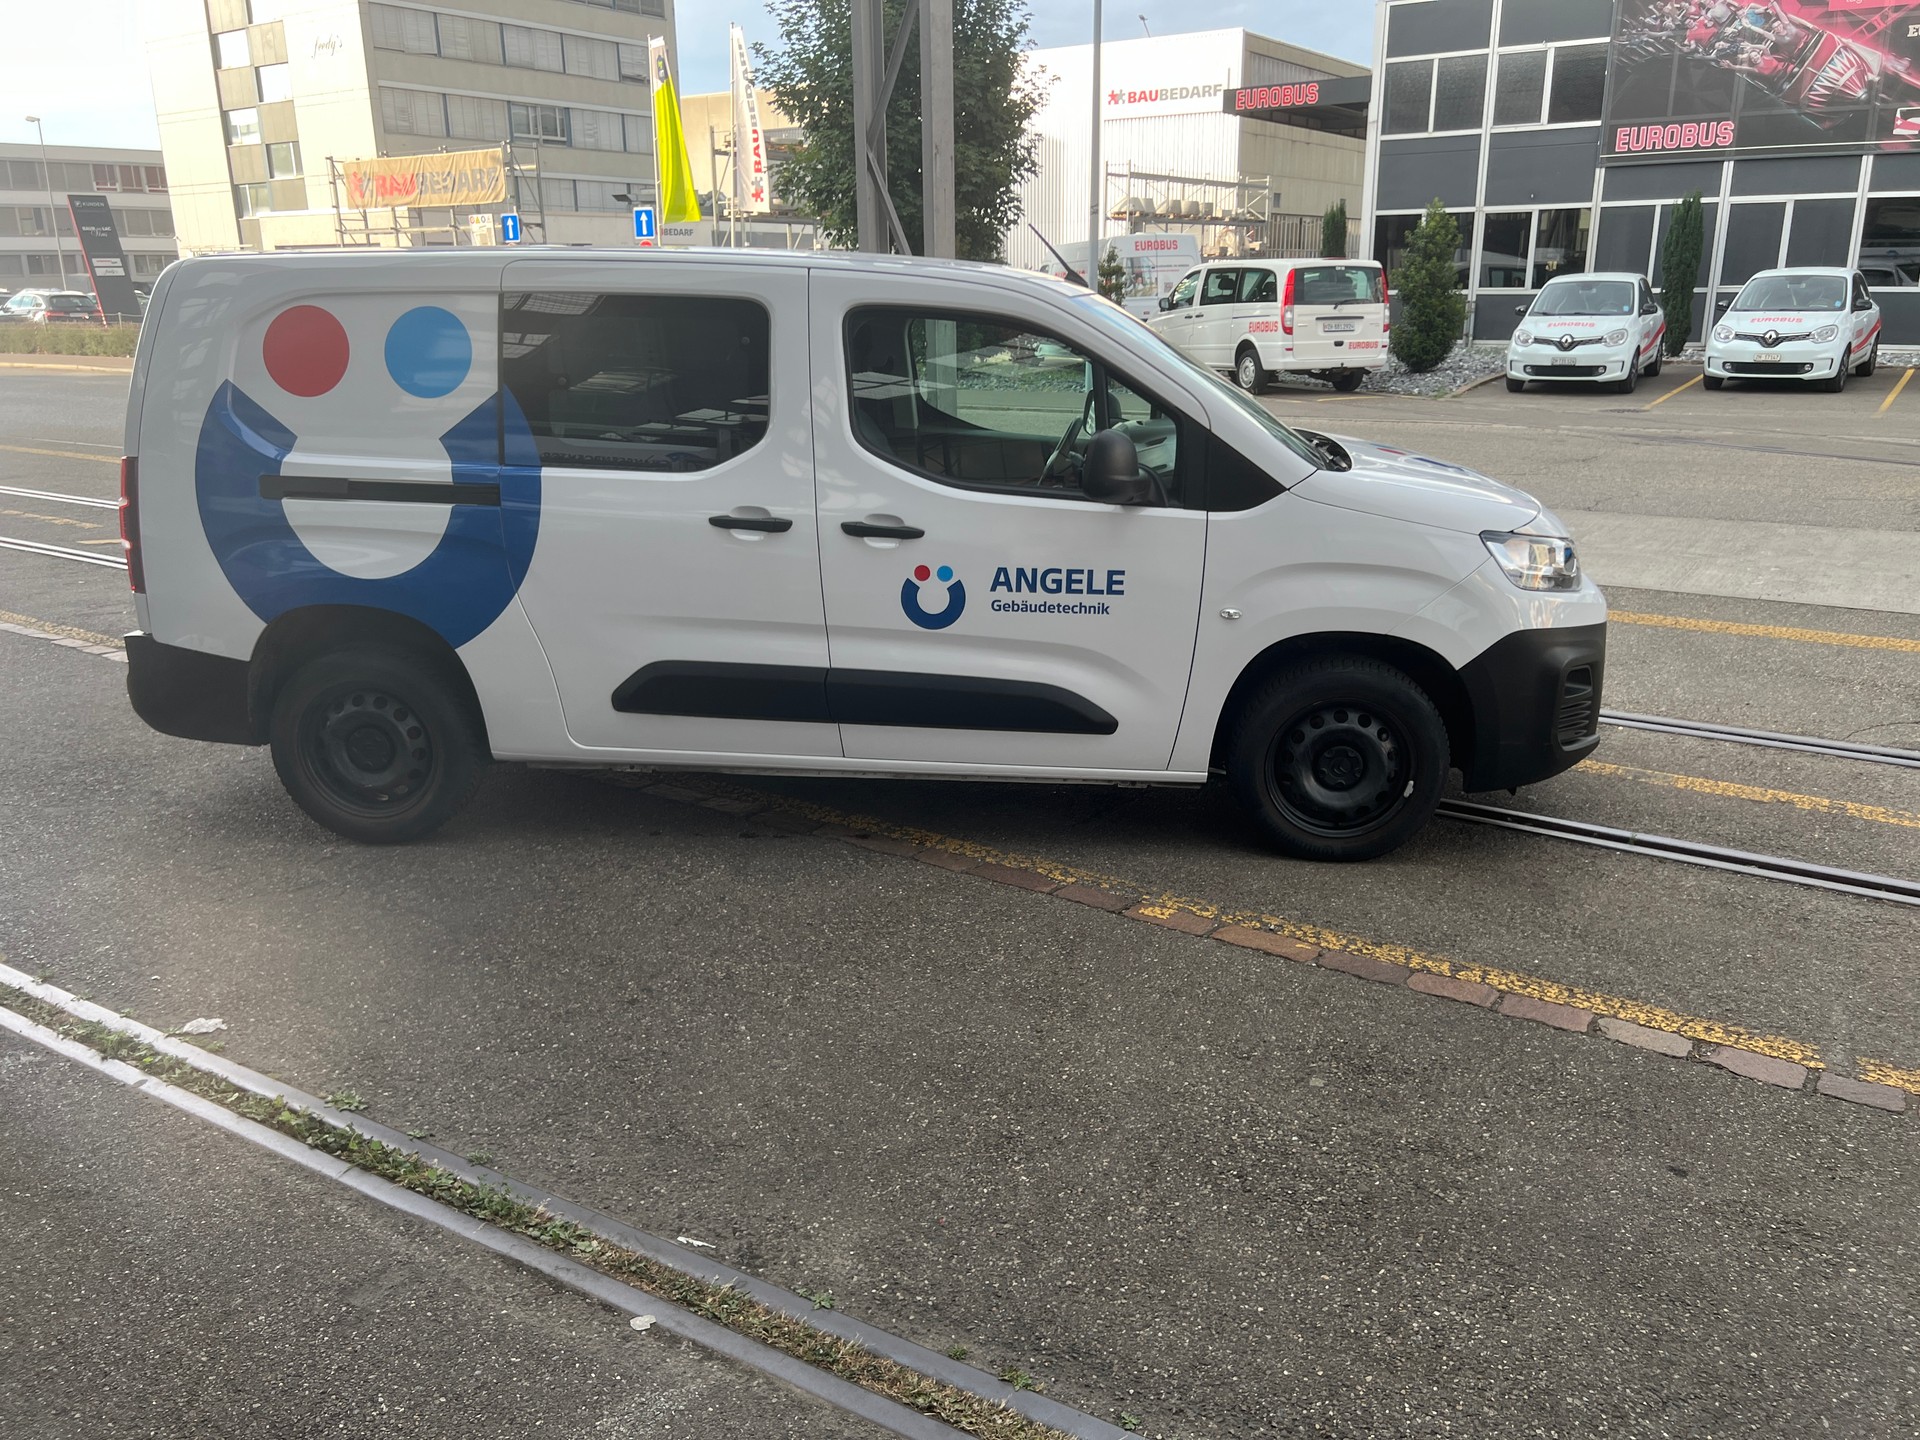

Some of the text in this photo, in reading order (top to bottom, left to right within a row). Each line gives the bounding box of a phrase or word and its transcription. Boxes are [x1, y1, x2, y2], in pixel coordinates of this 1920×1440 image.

[1127, 84, 1223, 104] BAUBEDARF
[1235, 82, 1319, 110] EUROBUS
[1615, 121, 1735, 152] EUROBUS
[1135, 240, 1178, 251] EUROBUS
[1248, 321, 1279, 333] EUROBUS
[1348, 341, 1379, 350] EUROBUS
[989, 566, 1126, 596] ANGELE
[990, 599, 1110, 615] Gebäudetechnik
